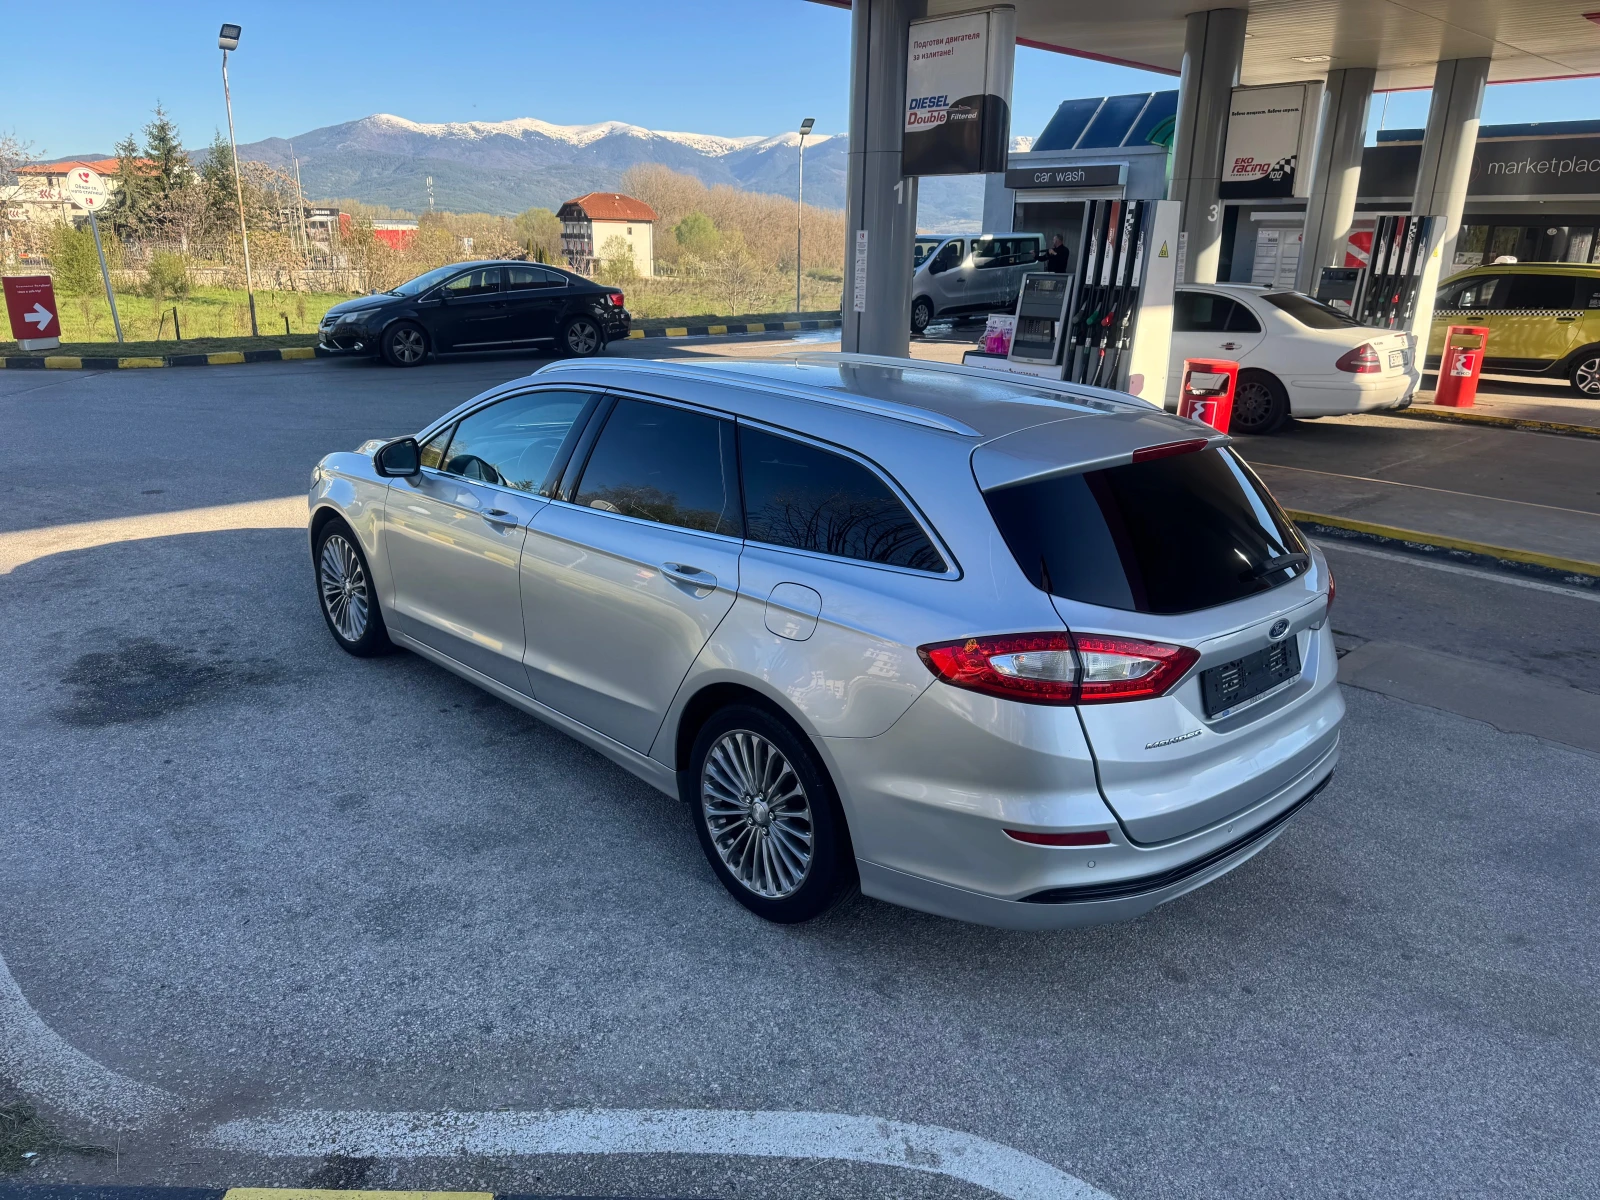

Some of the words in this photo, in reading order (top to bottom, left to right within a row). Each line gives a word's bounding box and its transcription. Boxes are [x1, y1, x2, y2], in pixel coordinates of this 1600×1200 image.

[913, 38, 944, 49] Подготви
[945, 32, 980, 45] двигателя
[921, 47, 954, 60] излитане!
[909, 95, 949, 110] DIESEL
[908, 112, 946, 125] Double
[951, 111, 978, 120] Filtered
[1034, 172, 1052, 183] car
[1056, 169, 1085, 182] wash
[1231, 163, 1271, 175] racing
[1269, 170, 1283, 179] 100
[893, 180, 904, 205] 1
[1207, 205, 1218, 222] 3
